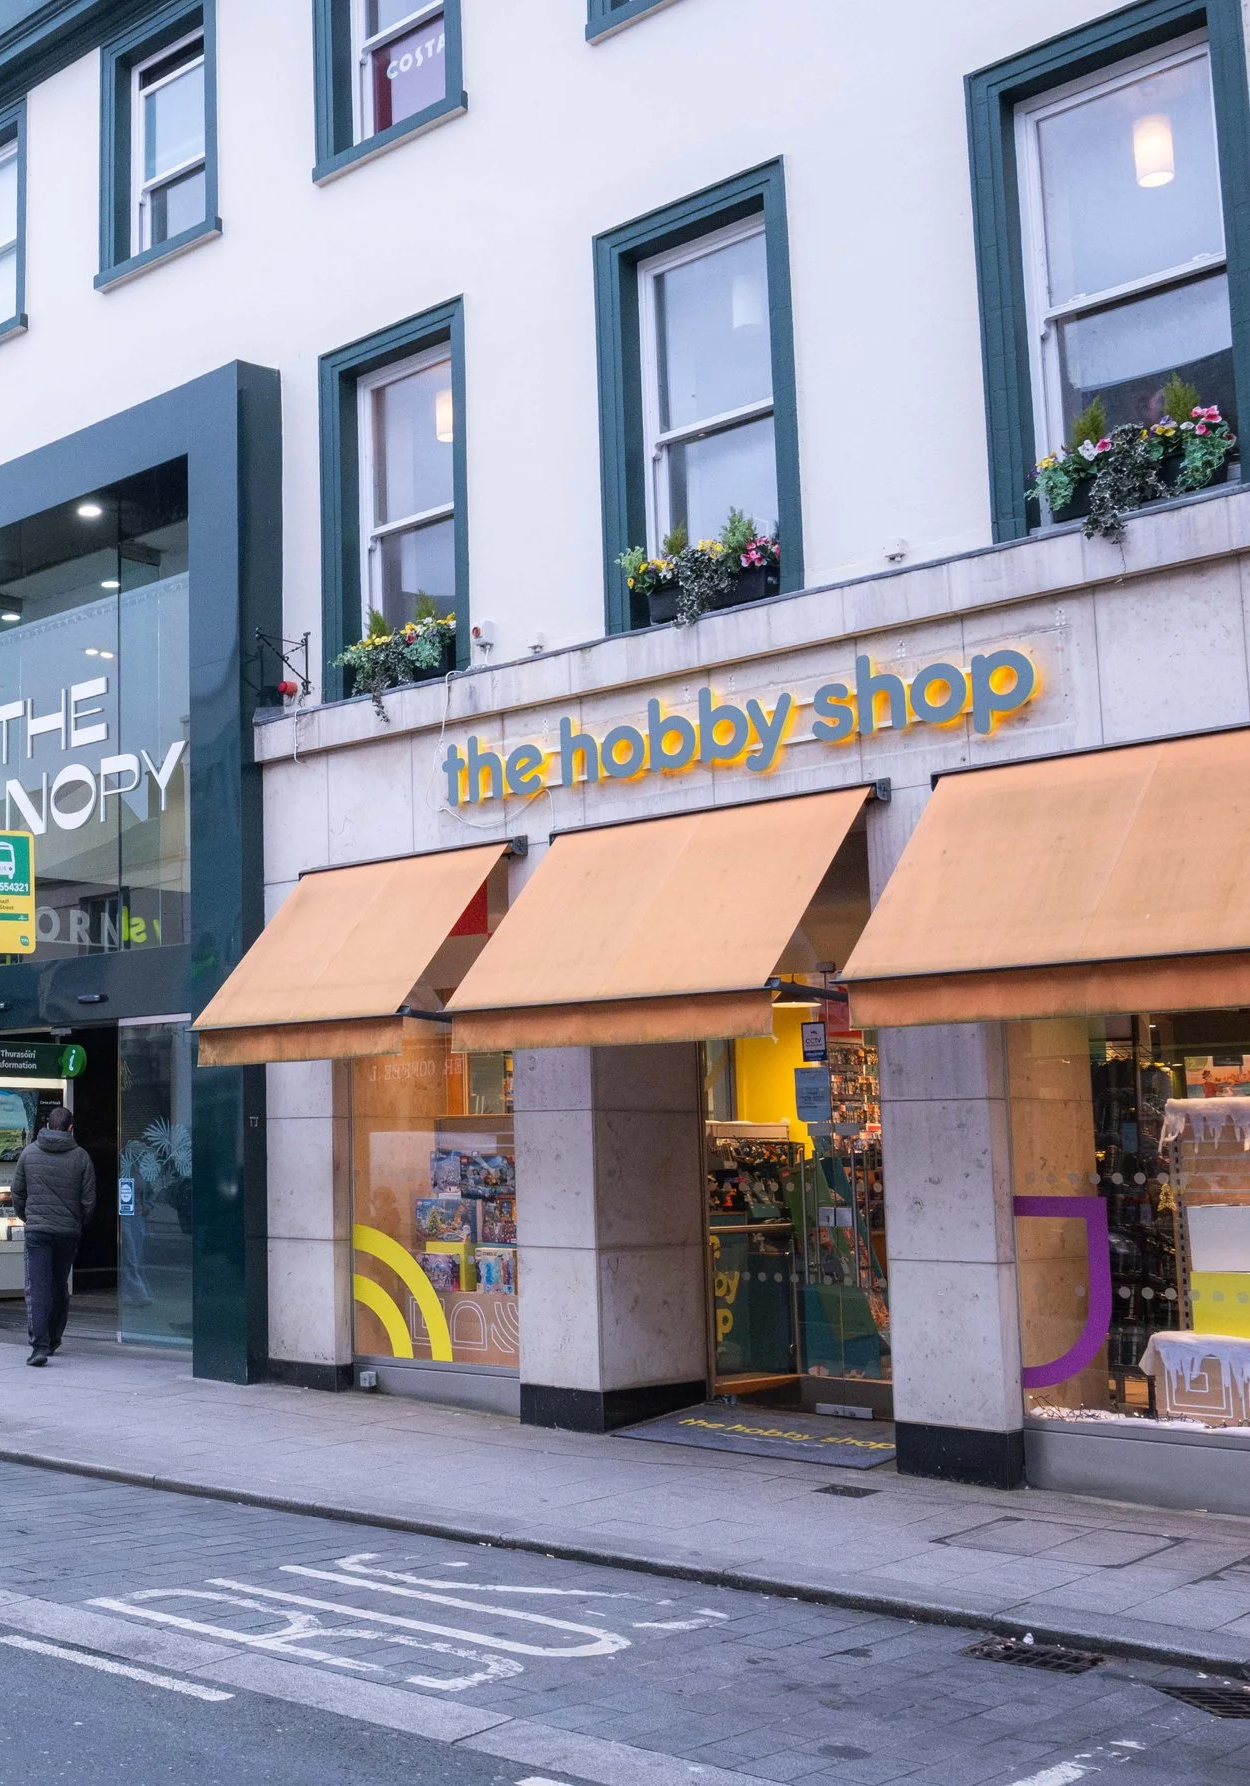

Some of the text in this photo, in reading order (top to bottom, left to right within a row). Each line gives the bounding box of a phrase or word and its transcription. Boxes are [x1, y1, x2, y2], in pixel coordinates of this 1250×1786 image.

[442, 648, 1036, 806] the hobby shop
[0, 882, 29, 893] 554321
[678, 1418, 896, 1450] the hobby shop
